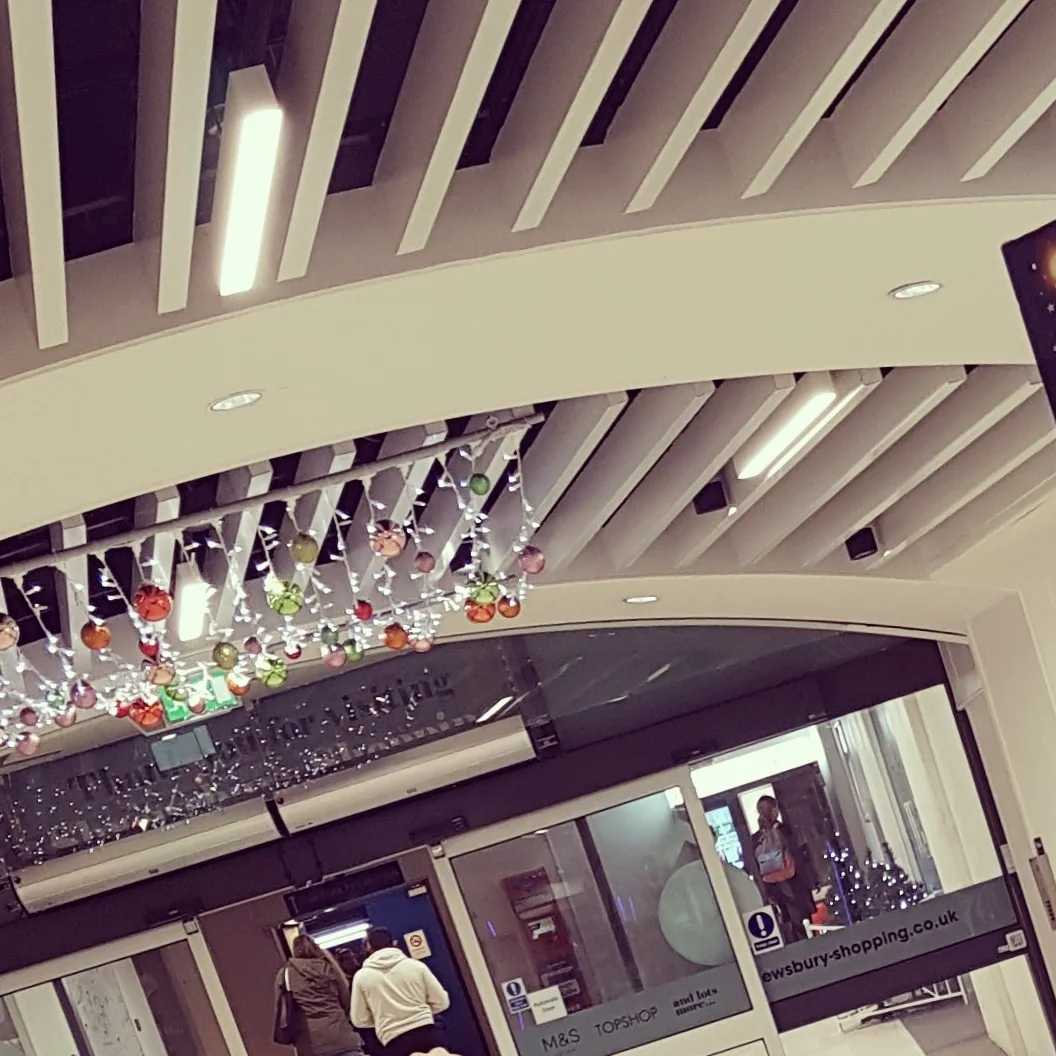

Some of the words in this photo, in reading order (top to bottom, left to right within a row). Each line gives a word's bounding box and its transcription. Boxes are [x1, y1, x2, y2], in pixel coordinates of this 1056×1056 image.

[672, 993, 694, 1008] and
[697, 987, 719, 1001] lots
[594, 1006, 659, 1036] TOPSHOP
[541, 1028, 580, 1052] M&S
